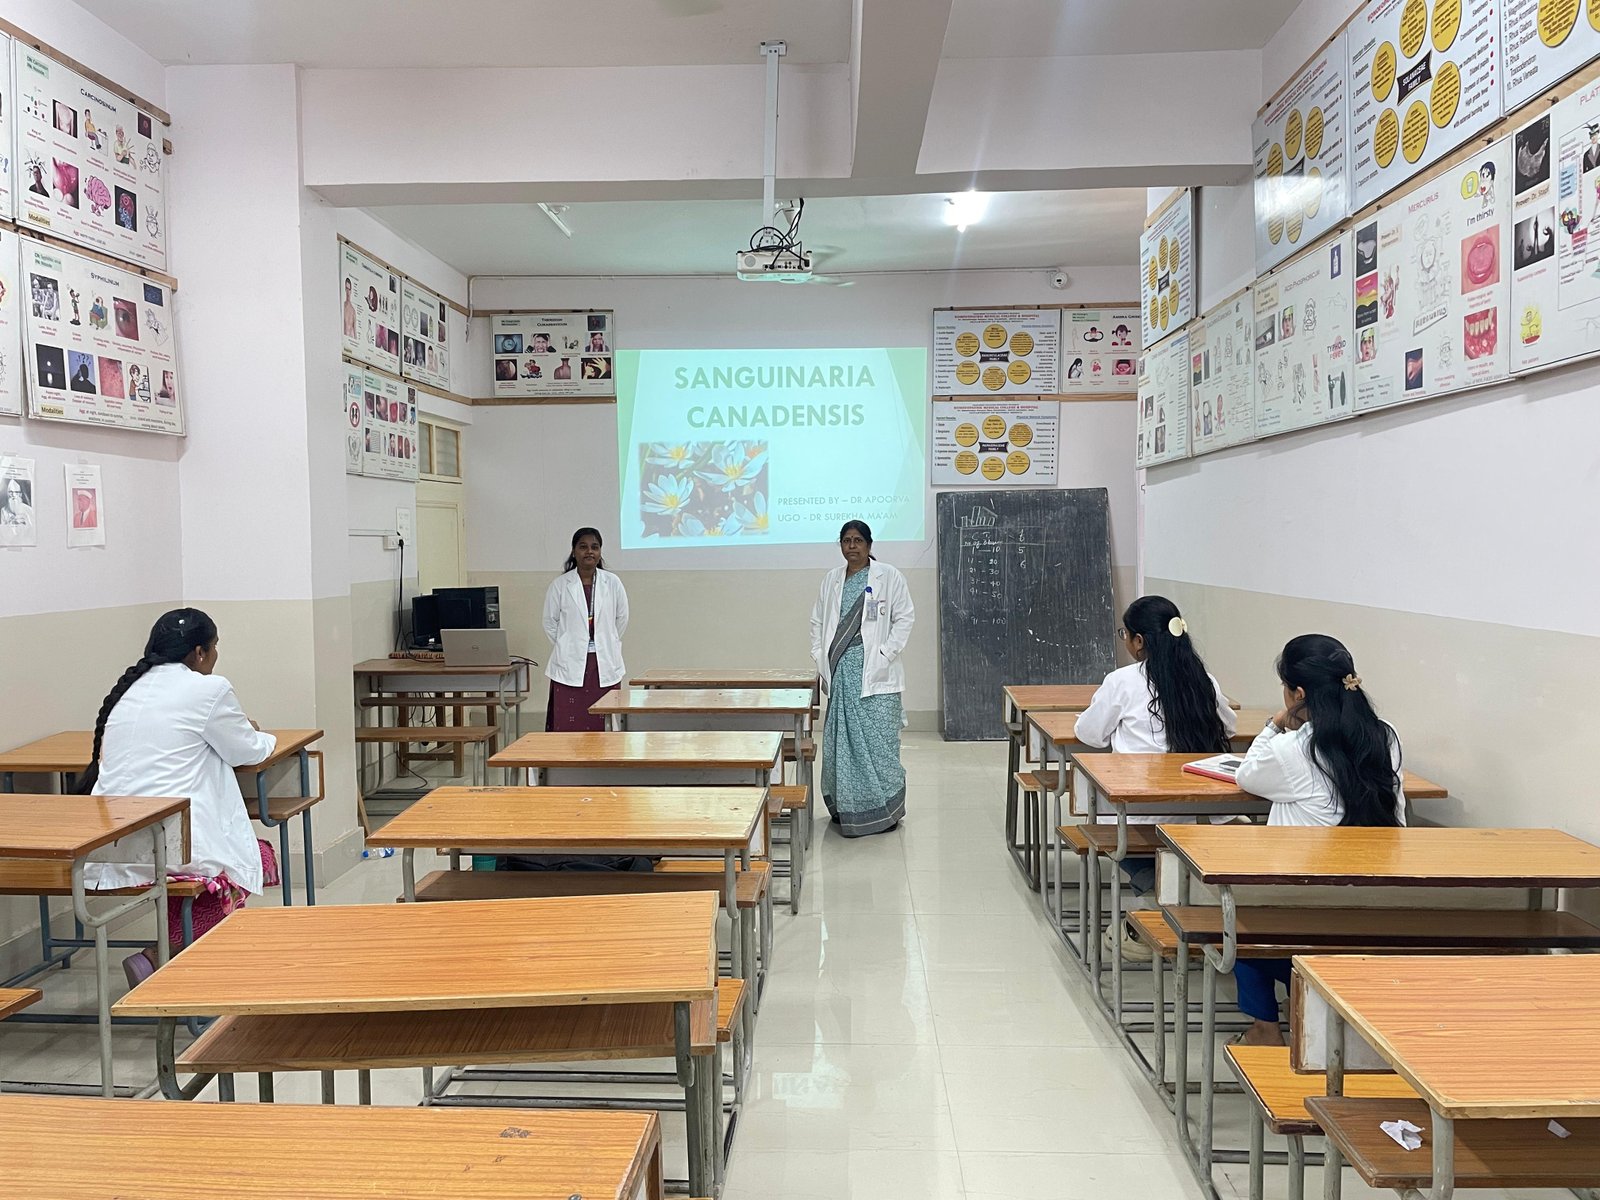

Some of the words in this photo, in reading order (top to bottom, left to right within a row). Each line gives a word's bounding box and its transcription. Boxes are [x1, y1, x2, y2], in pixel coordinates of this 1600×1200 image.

[1508, 16, 1518, 29] Rhus
[1509, 28, 1518, 41] Rhus
[1509, 40, 1518, 53] Rhus
[1509, 52, 1519, 65] Rhus
[1407, 76, 1420, 91] FAMILY
[1512, 75, 1522, 87] Rhus
[80, 87, 116, 113] CARCINOSINUM
[1408, 191, 1438, 215] MERCURIUS
[28, 212, 50, 226] Modalities
[1476, 206, 1494, 223] thirsty
[90, 272, 119, 288] SYPHILINUM
[1326, 340, 1346, 353] TYPHOID
[1329, 349, 1343, 360] FEVER
[674, 364, 876, 389] SANGUINARIA
[41, 406, 63, 415] Modalities
[686, 404, 865, 428] CANADENSIS
[778, 496, 825, 506] PRESENTED
[828, 496, 840, 505] BY
[850, 496, 864, 504] DR
[865, 495, 910, 504] APOORVA
[778, 513, 800, 522] UGO
[810, 513, 821, 522] DR
[824, 512, 865, 521] SUREKHA
[867, 511, 898, 520] MA'AM
[992, 591, 1002, 599] 50
